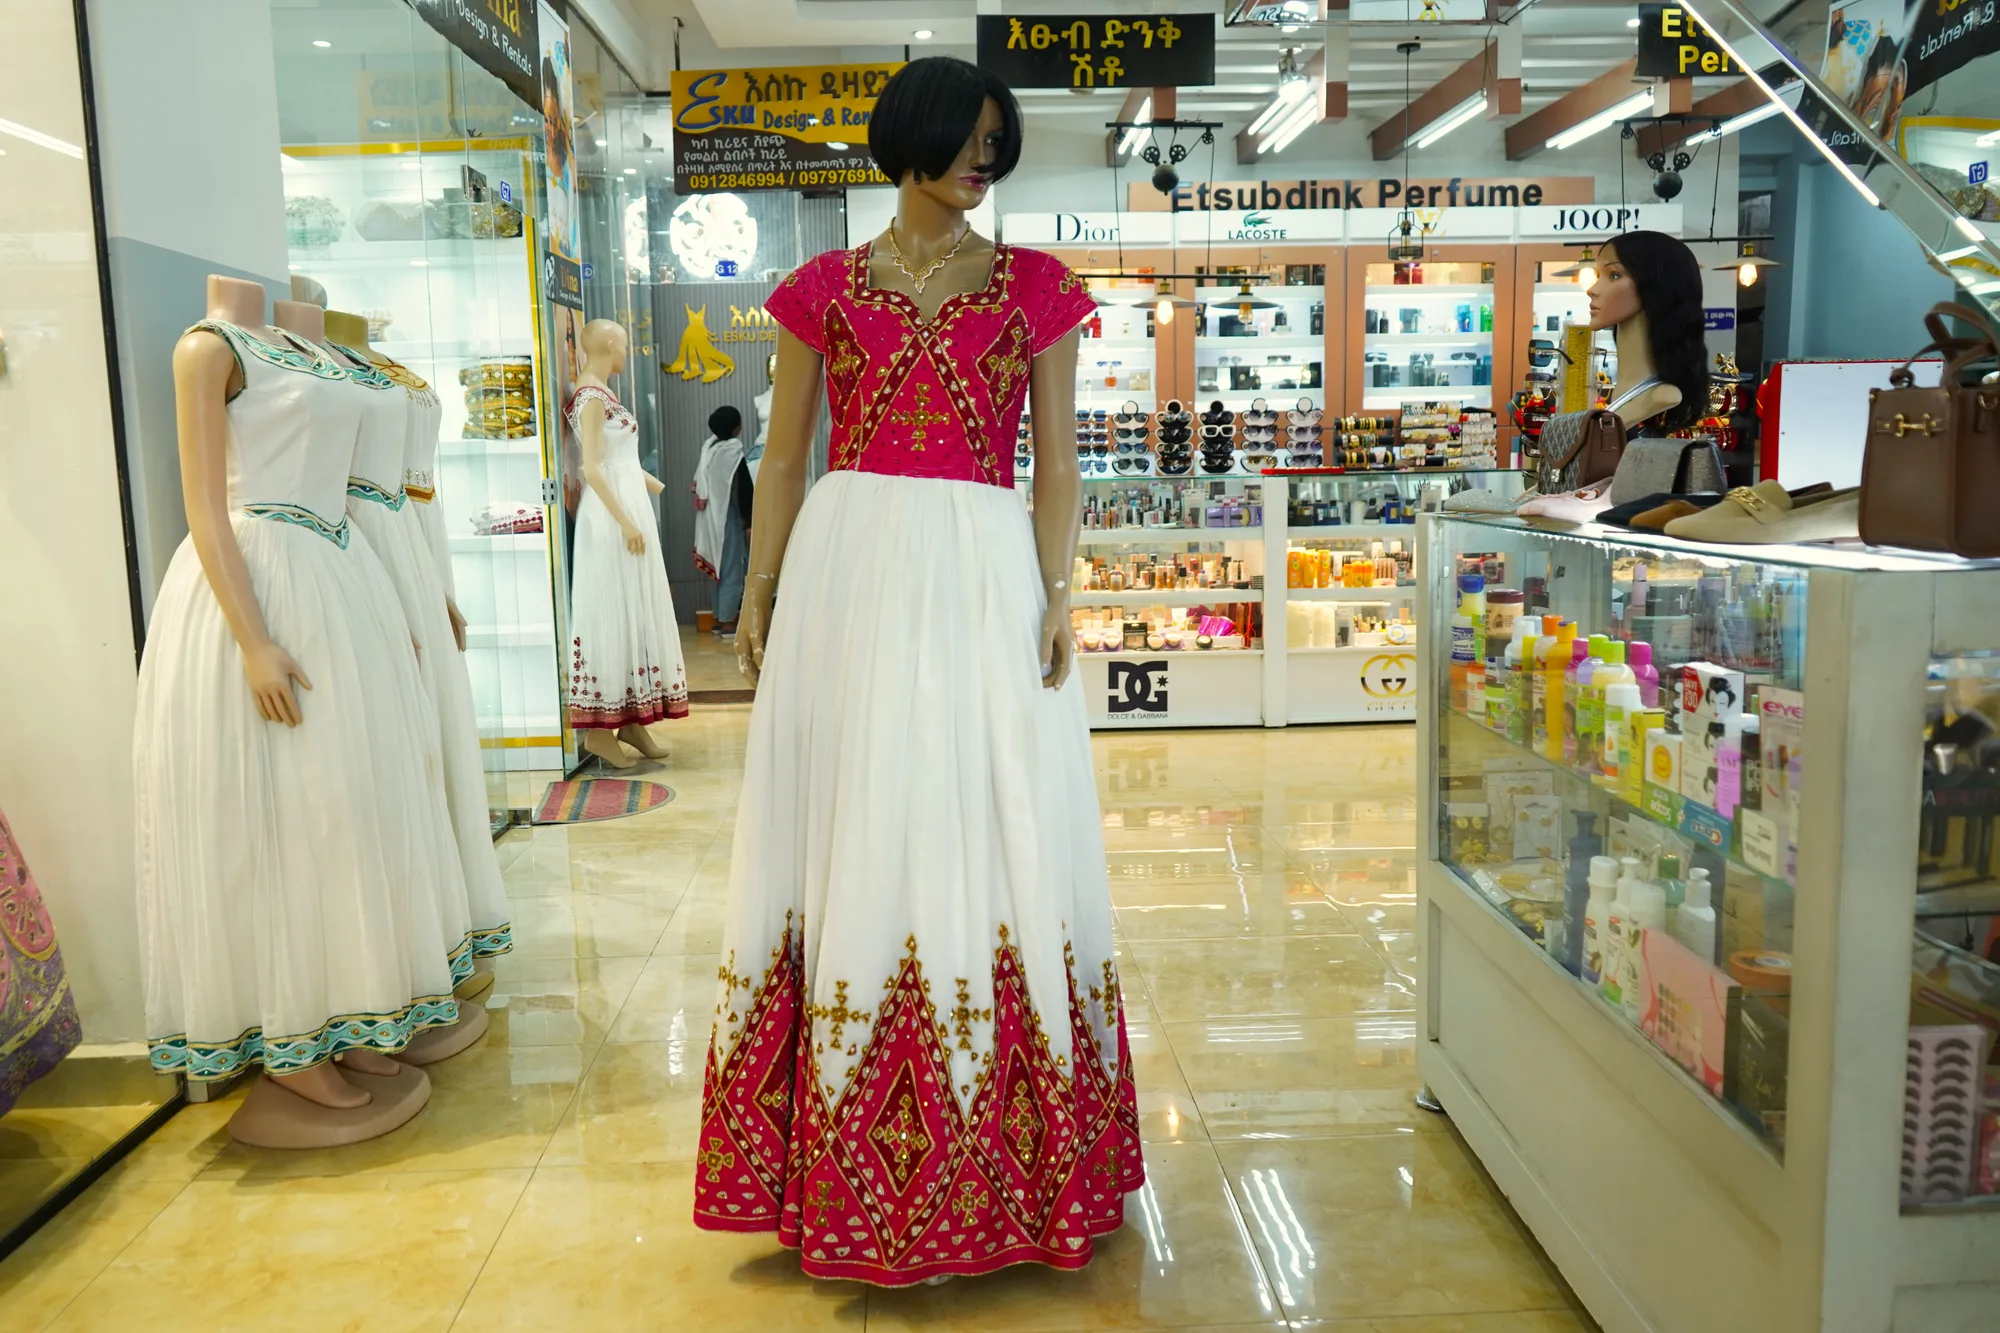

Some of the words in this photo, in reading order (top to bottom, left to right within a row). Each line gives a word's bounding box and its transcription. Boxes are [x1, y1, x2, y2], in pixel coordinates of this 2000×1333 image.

[459, 0, 489, 39] Design
[491, 25, 500, 48] &
[502, 34, 532, 76] Rentals
[1101, 17, 1182, 49] ድንቅ
[1070, 53, 1125, 87] ሽቶ
[1679, 45, 1745, 74] Per
[744, 72, 807, 102] እስኩ
[763, 109, 817, 132] Design
[822, 107, 836, 126] &
[501, 183, 510, 199] G7
[689, 172, 785, 189] 0912846994
[789, 172, 795, 185] /
[799, 168, 891, 186] 097976910
[1172, 179, 1364, 212] Etsubdink
[1378, 177, 1543, 208] Perfume
[1055, 213, 1121, 241] Dior
[1553, 208, 1640, 231] JOOP!
[1228, 229, 1287, 240] LACOSTE
[716, 264, 724, 274] G
[728, 264, 739, 274] 12
[723, 331, 756, 342] ESKU
[759, 331, 776, 341] DE
[1684, 678, 1698, 691] SAVE
